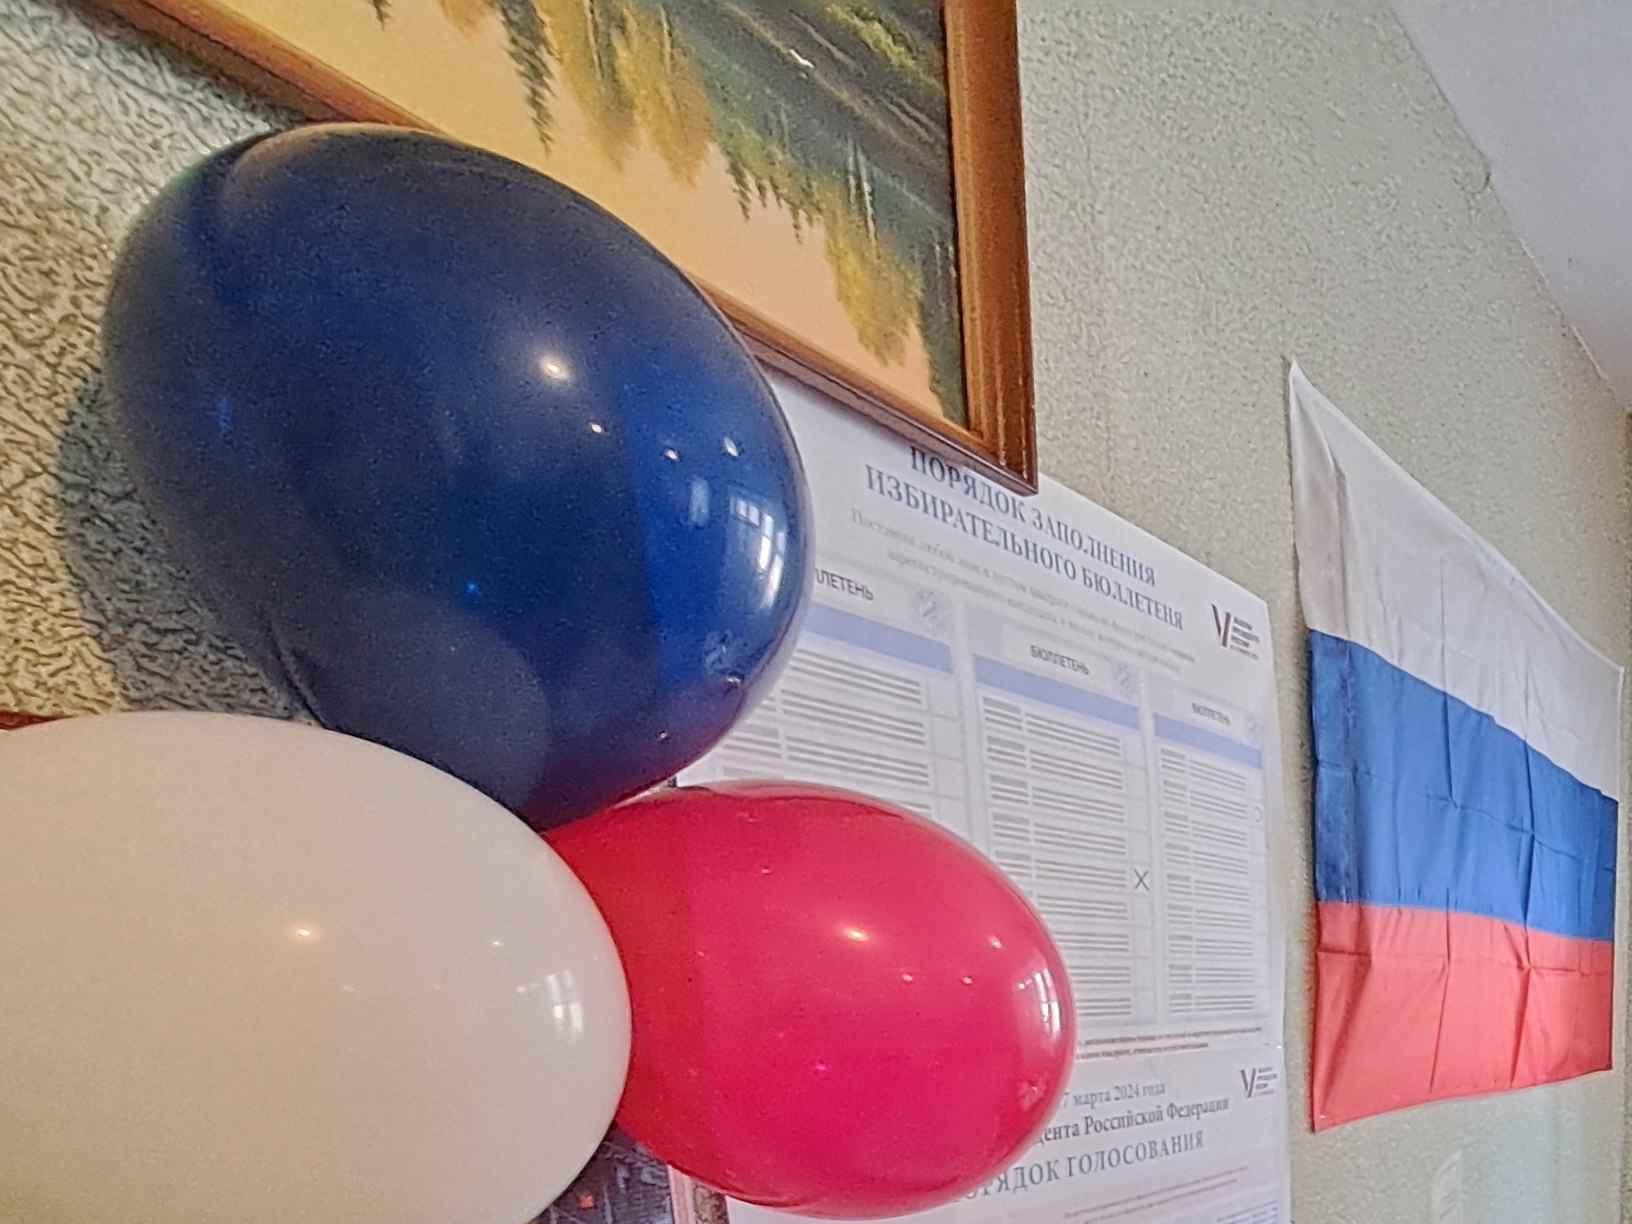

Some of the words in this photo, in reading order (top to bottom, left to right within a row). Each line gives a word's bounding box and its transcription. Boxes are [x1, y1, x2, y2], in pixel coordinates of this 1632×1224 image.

[909, 446, 1026, 524] ПОРЯДОК
[1031, 507, 1157, 588] ЗАПОЛНЕНИЯ
[865, 464, 1077, 581] ИЗБИРАТЕЛЬНОГО
[1081, 566, 1184, 631] БЮЛЛЕТЕНЯ
[1030, 644, 1090, 676] БЮЛЛЕТЕНЬ
[1113, 1084, 1143, 1102] 2024
[1084, 1103, 1165, 1135] Российской
[1166, 1097, 1230, 1121] Федерации
[1067, 1130, 1205, 1178] ГОЛОСОВАНИЯ
